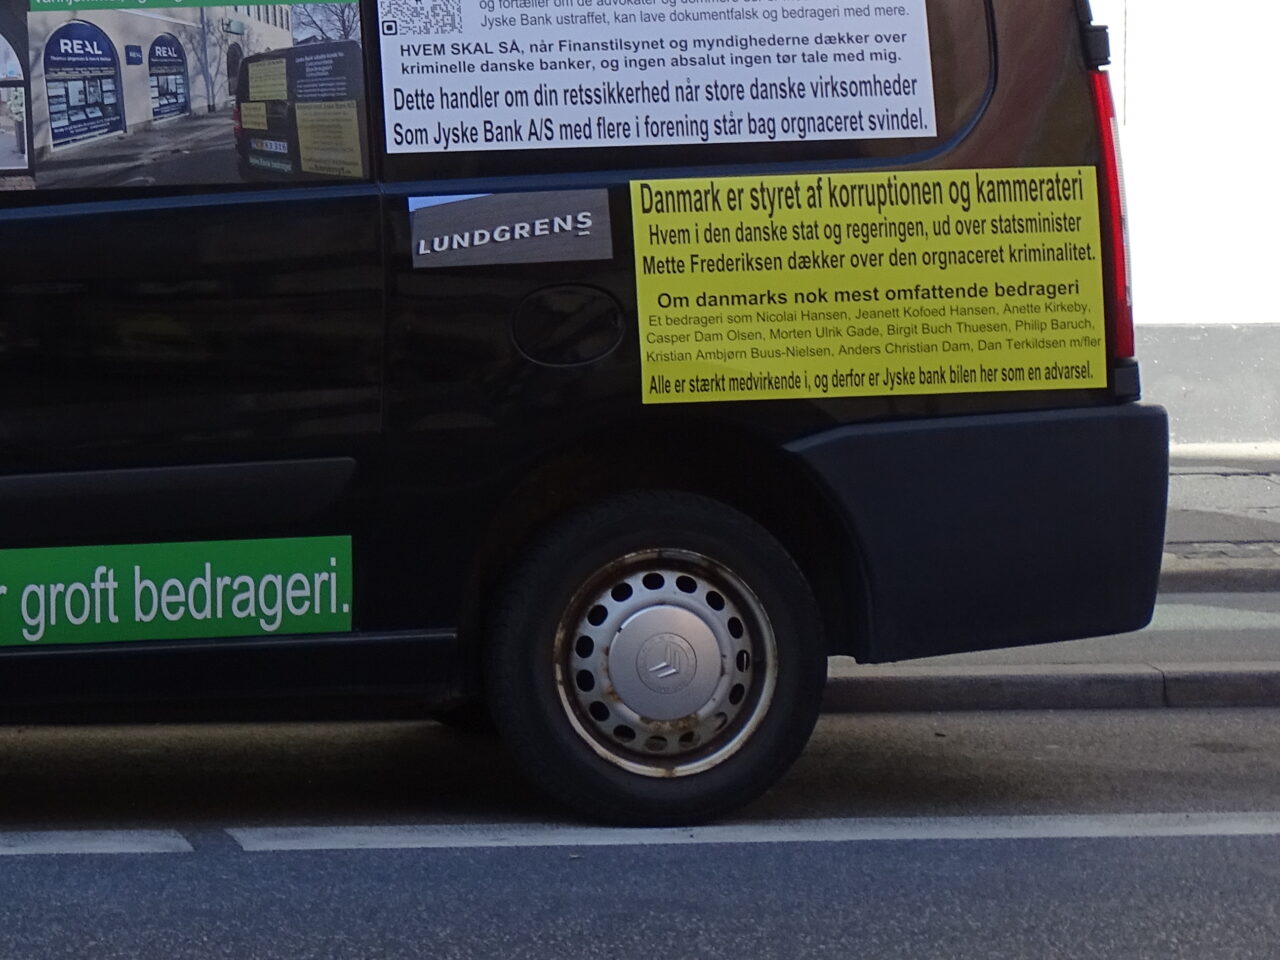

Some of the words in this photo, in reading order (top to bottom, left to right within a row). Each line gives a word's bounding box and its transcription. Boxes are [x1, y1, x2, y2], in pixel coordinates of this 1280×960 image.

[59, 39, 103, 55] REAL
[155, 46, 178, 58] REAL
[399, 42, 446, 57] HVEM
[449, 41, 494, 56] SKAL
[497, 39, 525, 55] SÅ,
[528, 41, 554, 53] når
[557, 37, 665, 53] Finanstilsynet
[668, 38, 688, 52] og
[692, 33, 810, 52] myndighederne
[813, 31, 870, 45] dækker
[873, 32, 907, 44] over
[392, 86, 435, 111] Dette
[438, 84, 500, 110] handler
[503, 89, 529, 108] om
[532, 82, 559, 107] din
[562, 78, 670, 106] retssikkerhed
[674, 83, 701, 102] når
[704, 79, 745, 102] store
[748, 75, 806, 100] danske
[808, 72, 918, 98] virksomheder
[639, 180, 722, 214] Danmark
[725, 186, 744, 212] er
[748, 179, 802, 219] styret
[805, 176, 823, 209] af
[826, 174, 943, 215] korruptionen
[947, 179, 971, 212] og
[974, 168, 1083, 203] kammerateri
[418, 211, 593, 255] LUNDGRENS
[647, 314, 662, 327] Et
[664, 313, 723, 328] bedrageri
[725, 313, 753, 324] som
[755, 310, 797, 323] Nicolai
[799, 309, 851, 321] Hansen,
[854, 307, 900, 320] Jeanett
[902, 304, 946, 318] Kofoed
[948, 304, 998, 316] Hansen,
[1001, 302, 1041, 314] Anette
[1043, 300, 1091, 315] Kirkeby,
[20, 564, 119, 642] groft
[133, 556, 350, 632] bedrageri.
